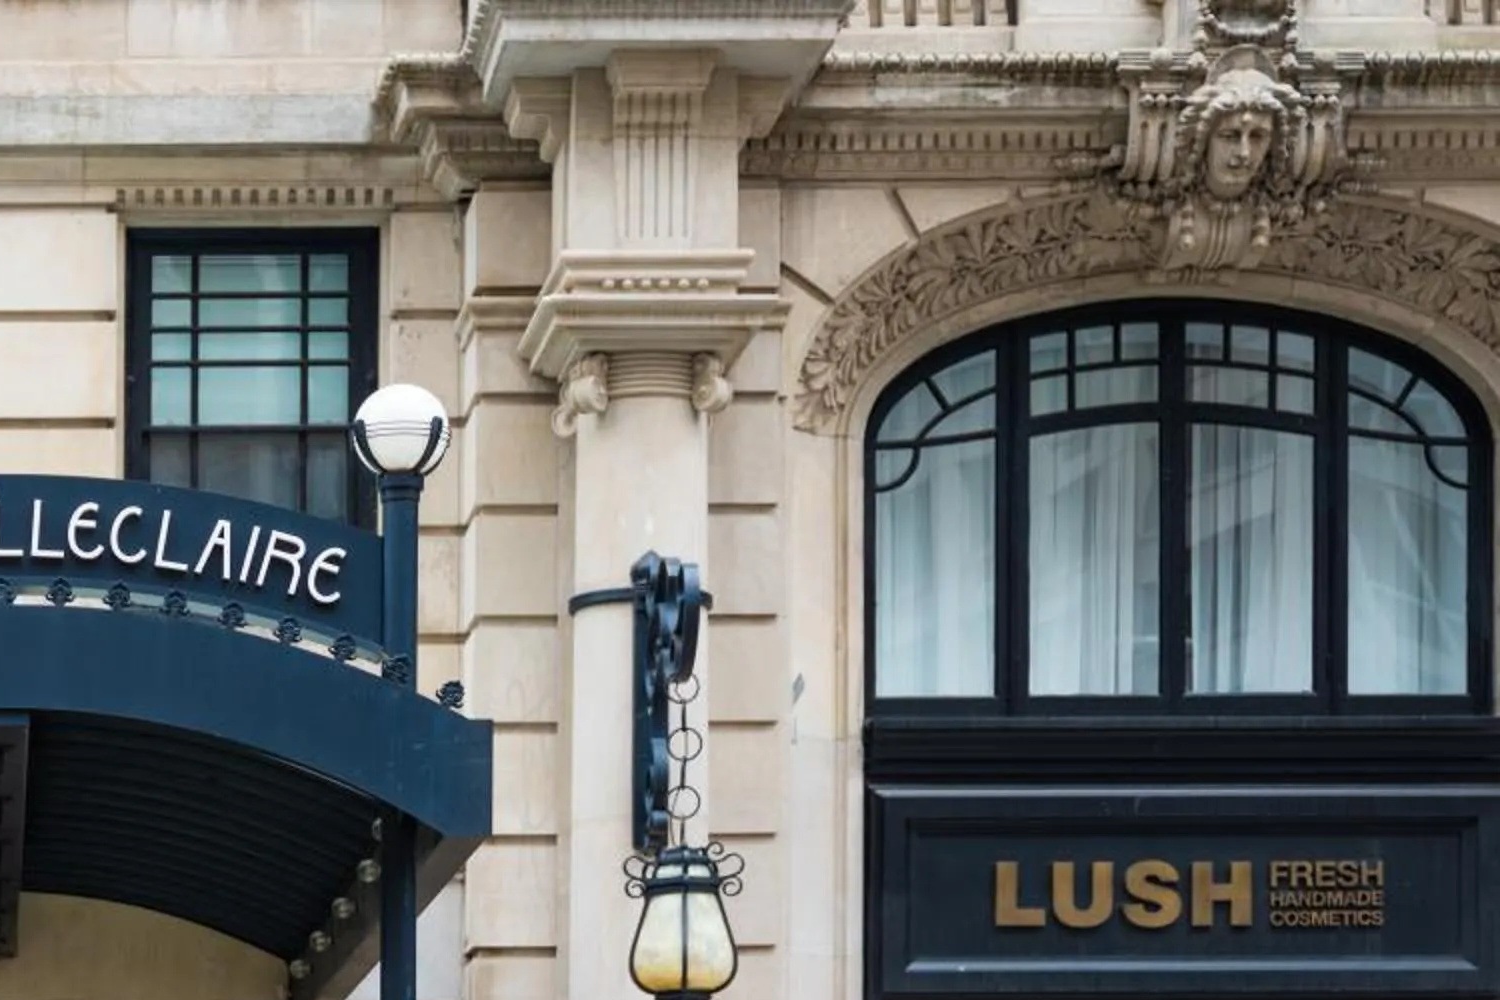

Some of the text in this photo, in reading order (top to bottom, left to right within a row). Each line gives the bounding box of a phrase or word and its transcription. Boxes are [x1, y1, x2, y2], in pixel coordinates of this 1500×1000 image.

[1269, 860, 1385, 887] FRESH
[995, 859, 1253, 929] LUSH
[1269, 889, 1385, 908] HANDMADE
[1269, 908, 1386, 927] COSMETICS
